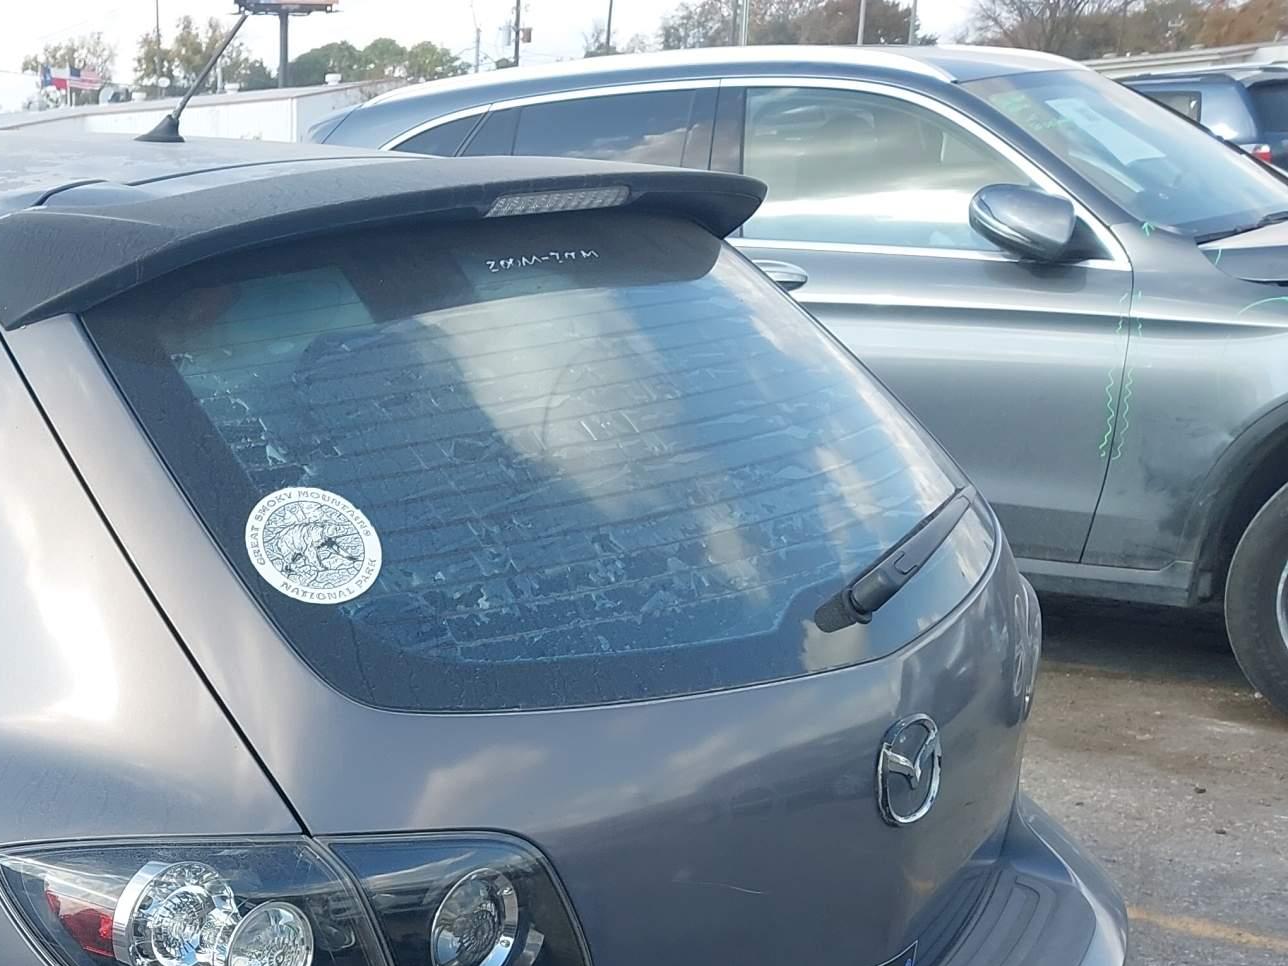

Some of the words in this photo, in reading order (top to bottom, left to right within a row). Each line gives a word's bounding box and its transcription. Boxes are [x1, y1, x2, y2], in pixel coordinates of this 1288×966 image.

[255, 491, 292, 522] SMOKY
[297, 490, 372, 537] MOUNTAINS
[250, 525, 266, 566] GREAT
[280, 581, 356, 601] NATIONAL
[355, 558, 378, 588] PARK
